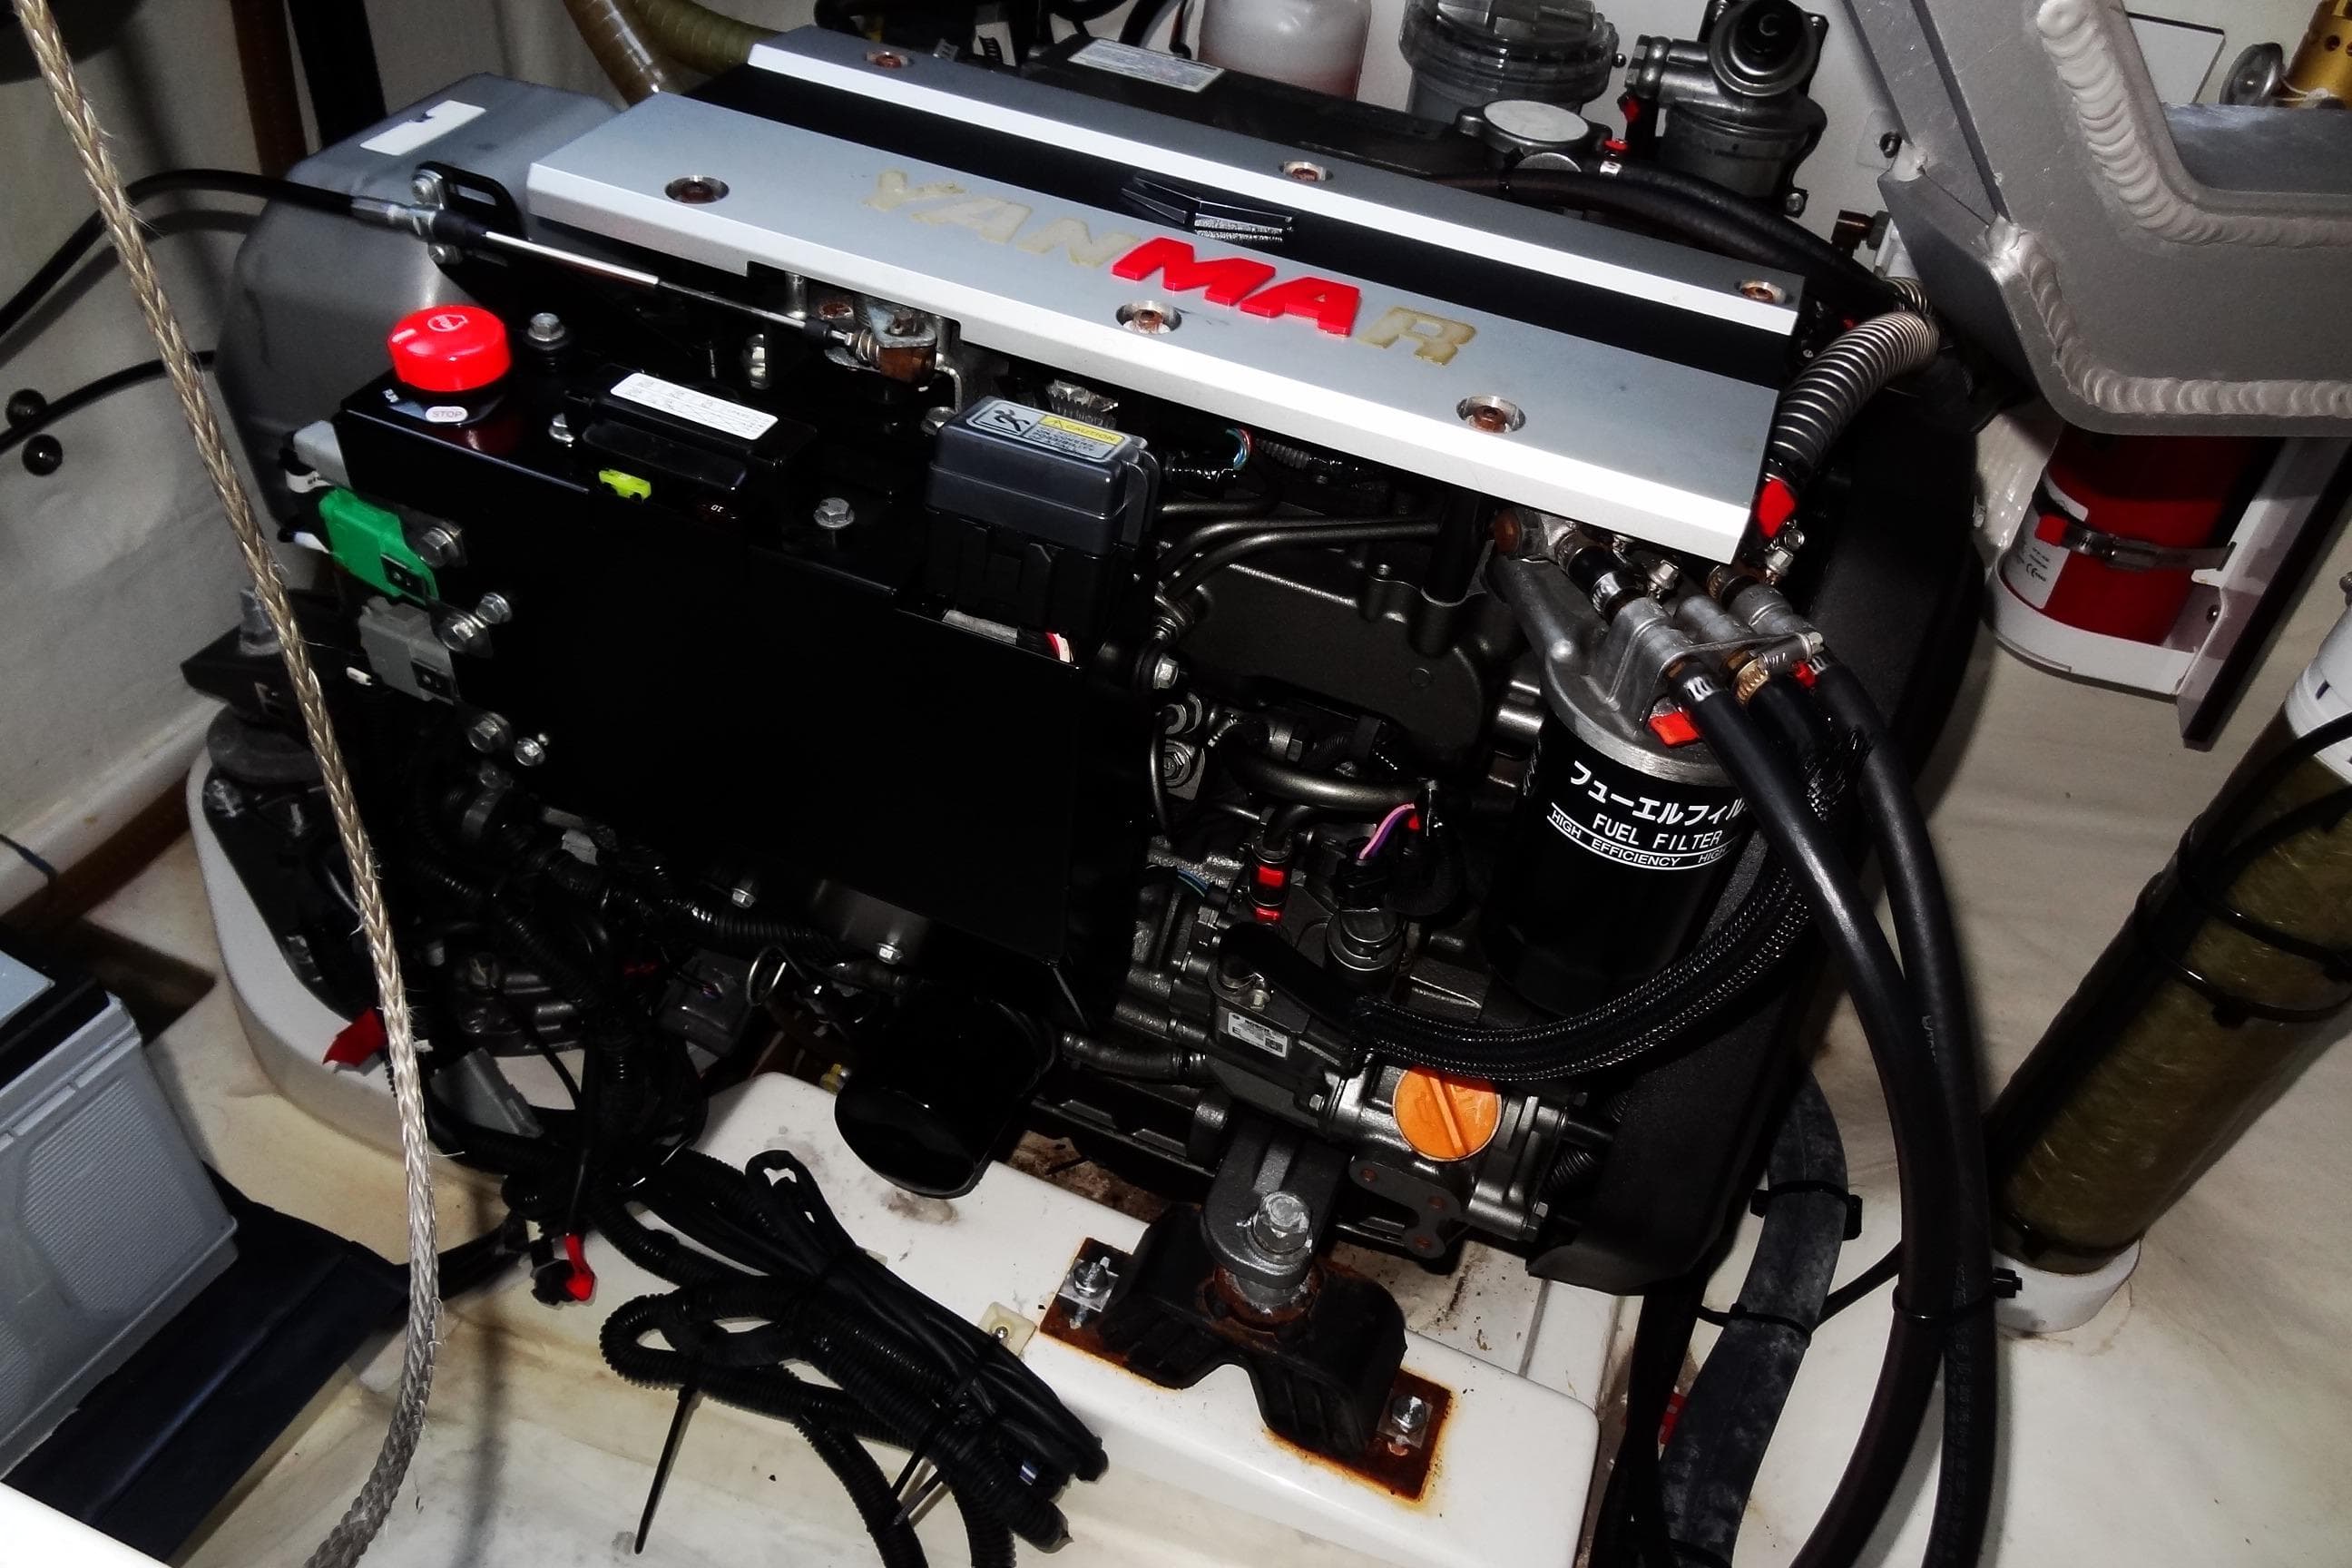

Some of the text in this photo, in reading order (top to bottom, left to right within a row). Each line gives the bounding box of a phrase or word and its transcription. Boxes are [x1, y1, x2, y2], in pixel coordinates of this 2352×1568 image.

[860, 170, 1477, 366] YANMAR
[1065, 424, 1116, 441] CAUTION
[1570, 760, 1749, 827] フューエルフィル
[1551, 809, 1583, 840] HIGH
[1591, 838, 1681, 867] EFFICIENCY
[1592, 812, 1723, 851] FUEL FILTER
